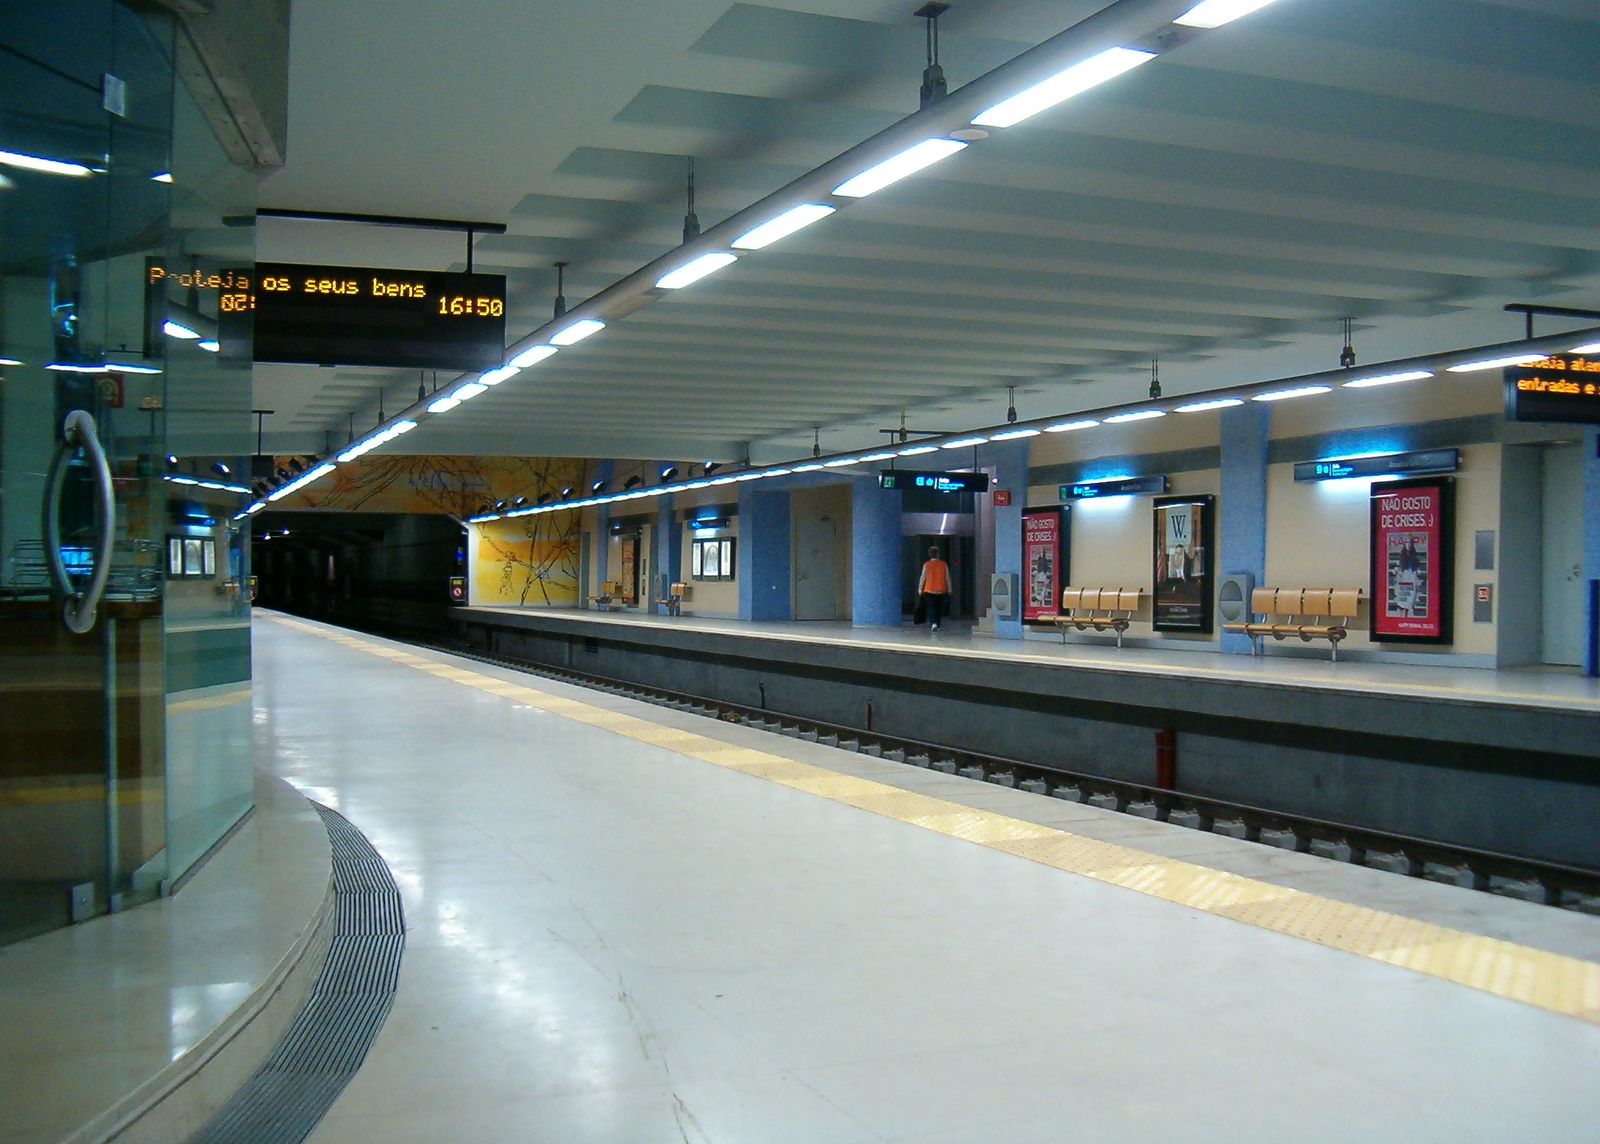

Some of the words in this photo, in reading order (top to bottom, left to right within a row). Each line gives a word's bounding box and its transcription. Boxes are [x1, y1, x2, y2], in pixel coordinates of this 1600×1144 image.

[262, 276, 291, 292] os
[304, 278, 360, 295] seus
[372, 277, 427, 299] bens
[439, 296, 503, 317] 16:50
[1517, 377, 1580, 393] entradas
[1584, 384, 1596, 394] e
[1402, 496, 1431, 510] GOSTO
[1170, 514, 1187, 539] W.
[1381, 514, 1393, 528] DE
